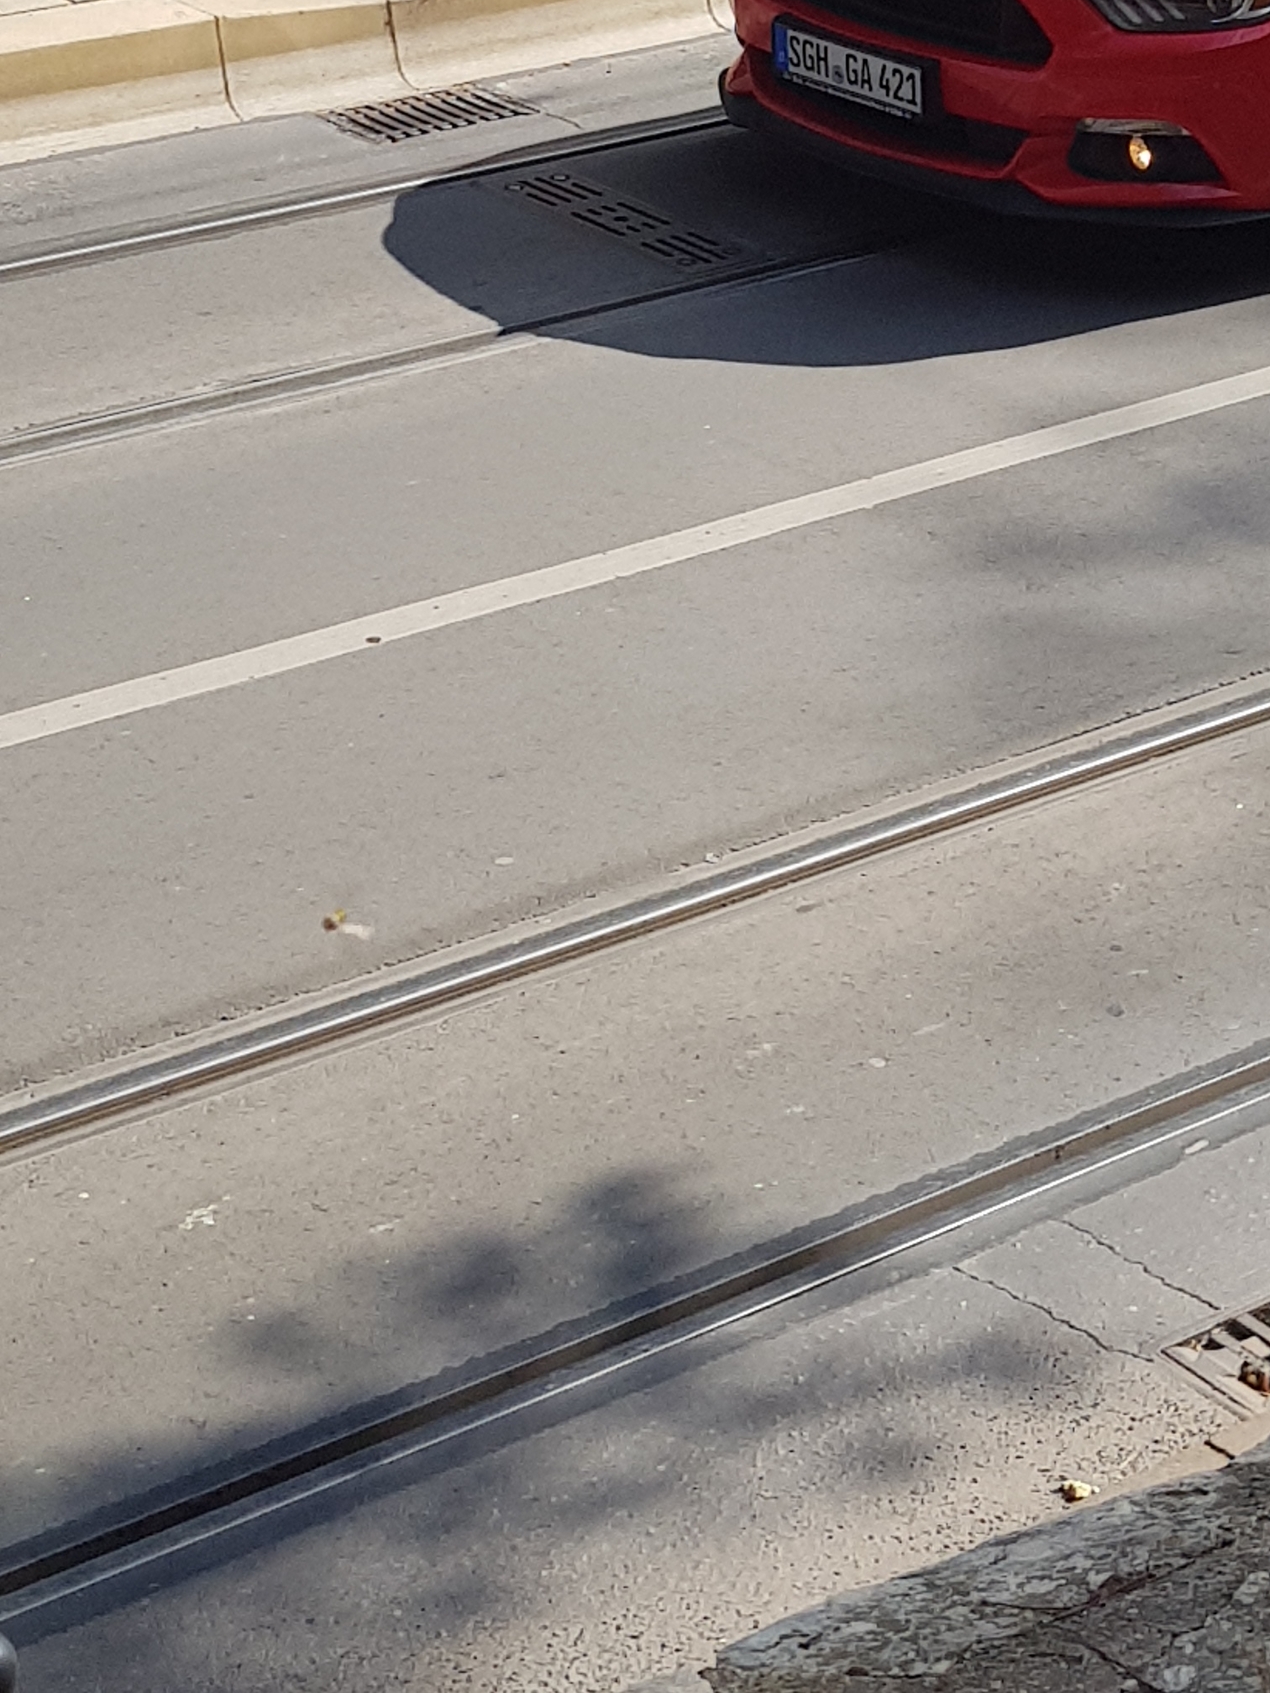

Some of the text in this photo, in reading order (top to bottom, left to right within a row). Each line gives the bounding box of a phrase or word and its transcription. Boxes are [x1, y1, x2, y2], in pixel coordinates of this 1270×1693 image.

[788, 34, 830, 79] SGH
[845, 52, 874, 93] GA
[878, 62, 918, 107] 421
